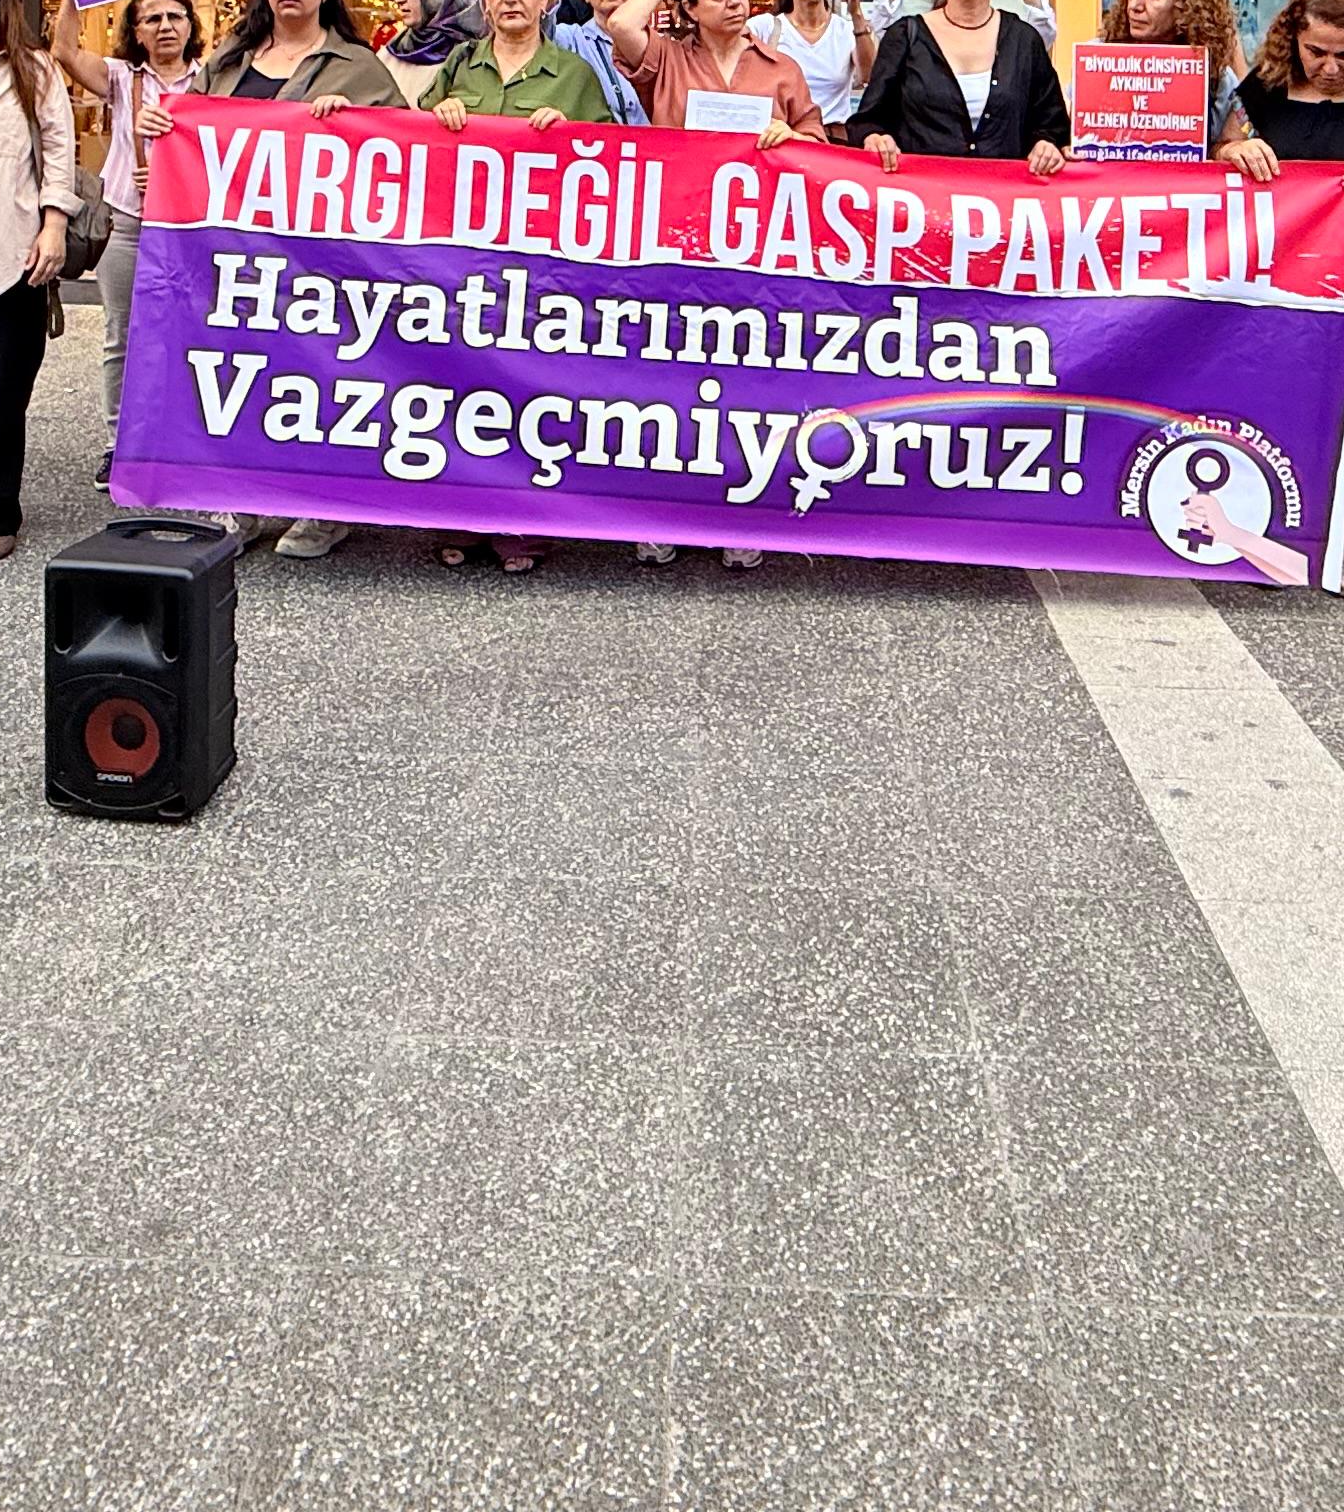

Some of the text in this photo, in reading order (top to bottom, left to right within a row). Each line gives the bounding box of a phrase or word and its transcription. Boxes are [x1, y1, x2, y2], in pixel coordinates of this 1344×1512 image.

[1079, 55, 1204, 75] "BİYOLOJİK CİNSİYETE
[1110, 75, 1173, 93] AYKIRILIK"
[1132, 95, 1149, 111] VE
[1077, 111, 1204, 132] "ALENEN ÖZENDİRME"
[1076, 148, 1125, 162] muğlak
[198, 124, 1275, 295] YARGI DEĞİL GASP PAKETİ!
[206, 250, 1057, 388] Hayatlarımızdan
[187, 348, 1088, 516] Vazgeçmiyoruz!
[1121, 415, 1302, 528] Mersin Kadın Platformu
